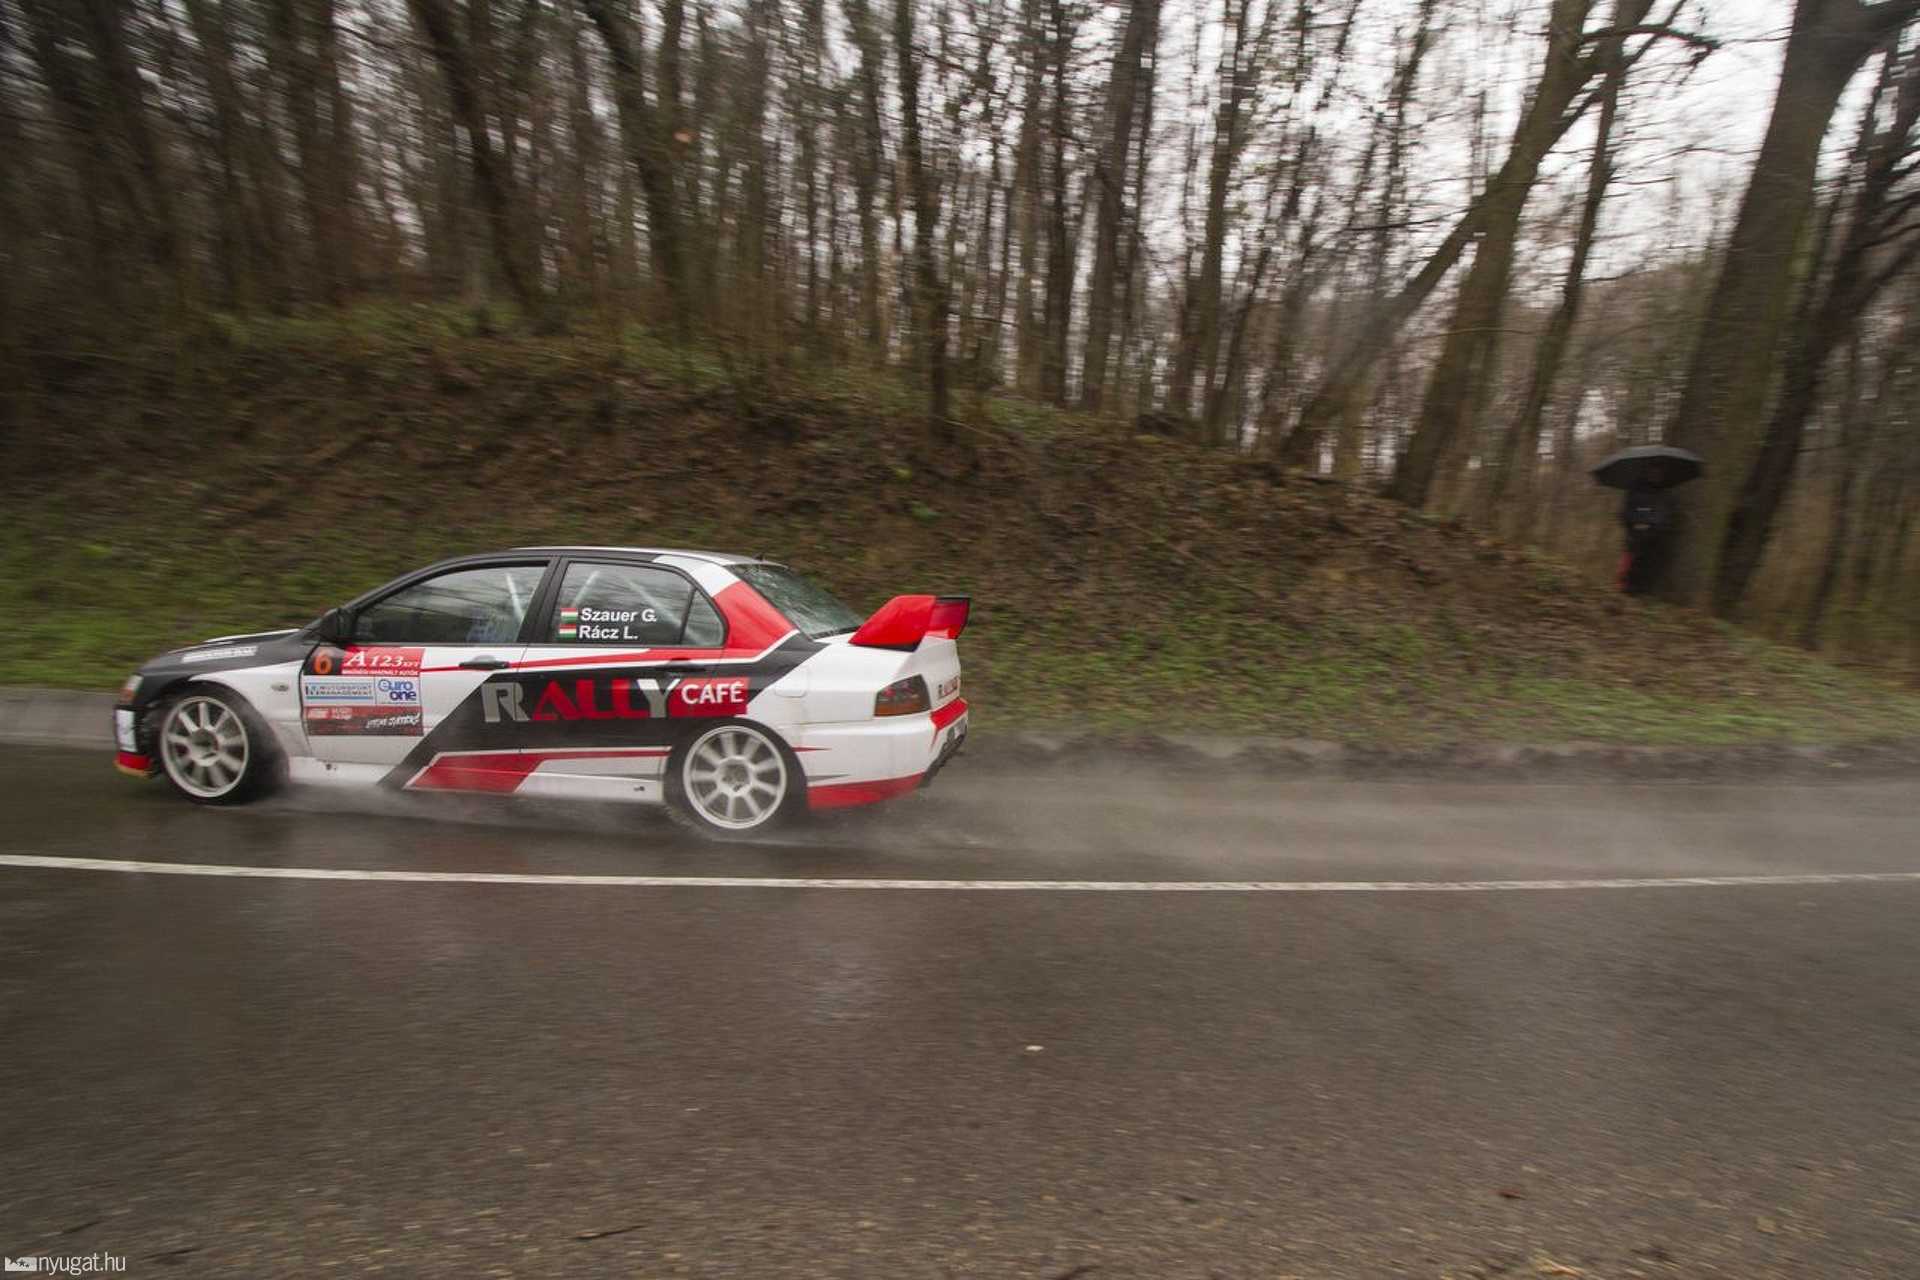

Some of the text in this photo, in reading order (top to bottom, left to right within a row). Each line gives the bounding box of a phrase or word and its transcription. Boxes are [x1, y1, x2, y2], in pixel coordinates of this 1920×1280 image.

[580, 607, 657, 622] Szauer G.
[578, 625, 638, 640] Rácz L.
[389, 690, 417, 701] one
[481, 678, 681, 723] RALLY
[680, 681, 744, 705] CAFÉ
